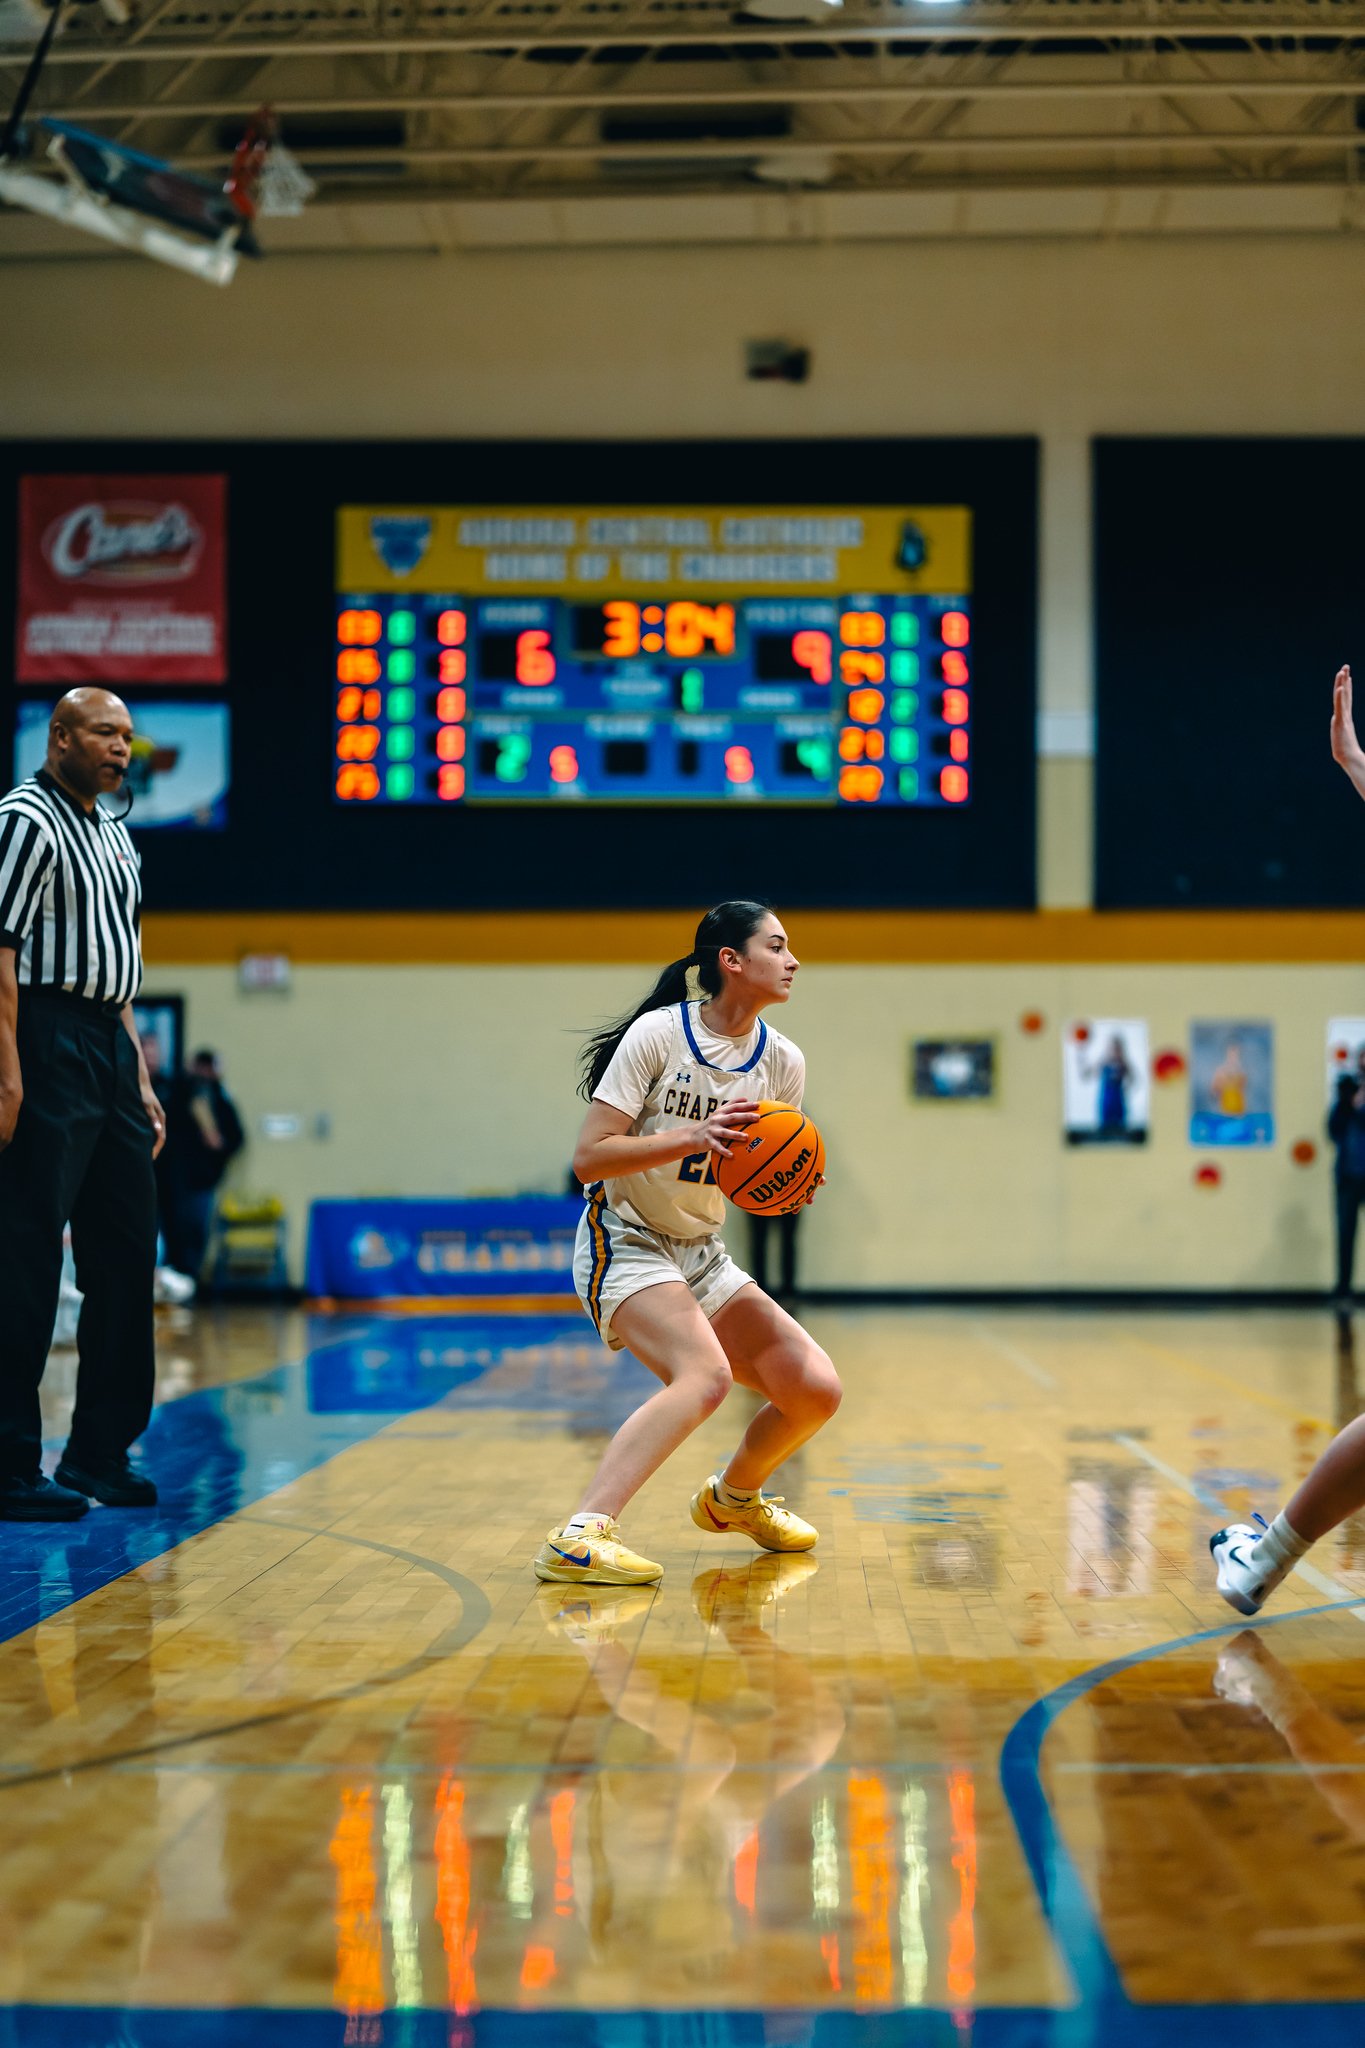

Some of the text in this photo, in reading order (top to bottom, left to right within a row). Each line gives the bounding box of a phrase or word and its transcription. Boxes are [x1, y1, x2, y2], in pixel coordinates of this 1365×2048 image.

[54, 504, 197, 576] Cane's
[602, 601, 736, 657] 3:04
[516, 630, 556, 686] 6
[791, 630, 832, 685] 9
[663, 1088, 731, 1121] CHAR
[747, 1147, 812, 1203] Wilson
